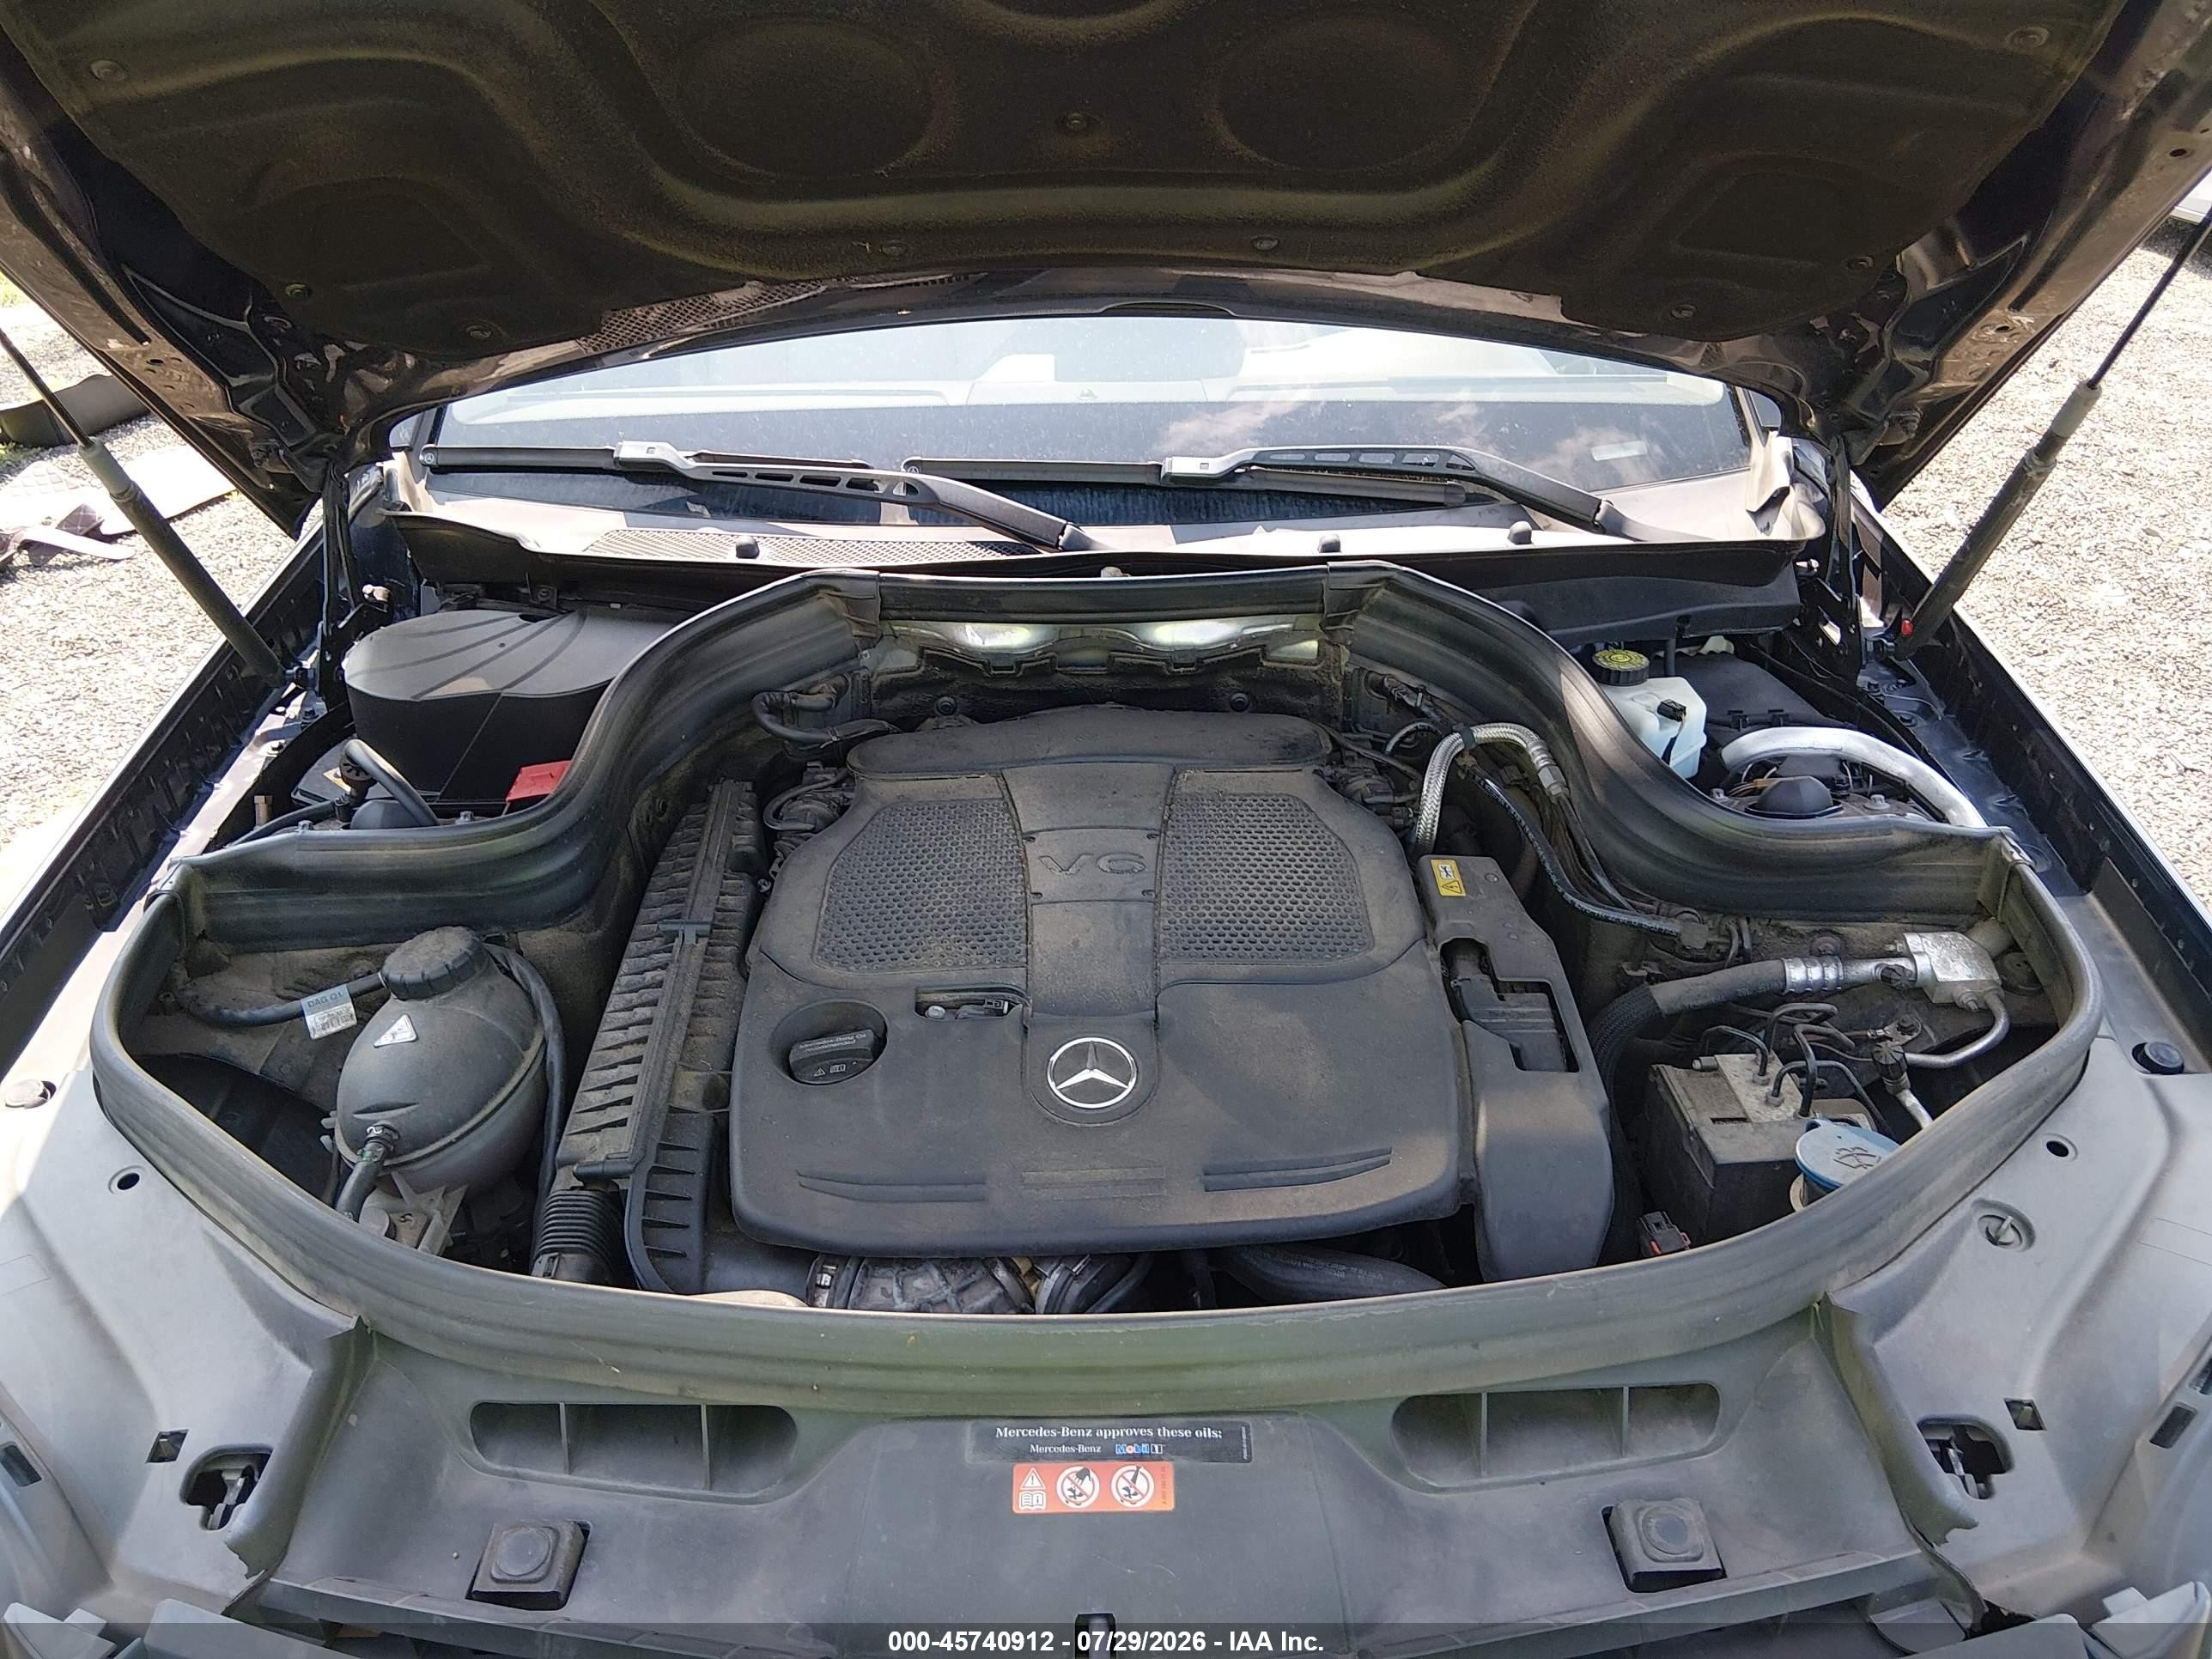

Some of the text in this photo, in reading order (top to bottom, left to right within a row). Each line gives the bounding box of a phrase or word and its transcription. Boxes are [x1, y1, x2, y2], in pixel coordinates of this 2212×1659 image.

[1038, 852, 1146, 875] V6
[995, 1426, 1223, 1439] Mercedes-Benz approves these oils:
[1030, 1443, 1102, 1454] Mercedes-Benz
